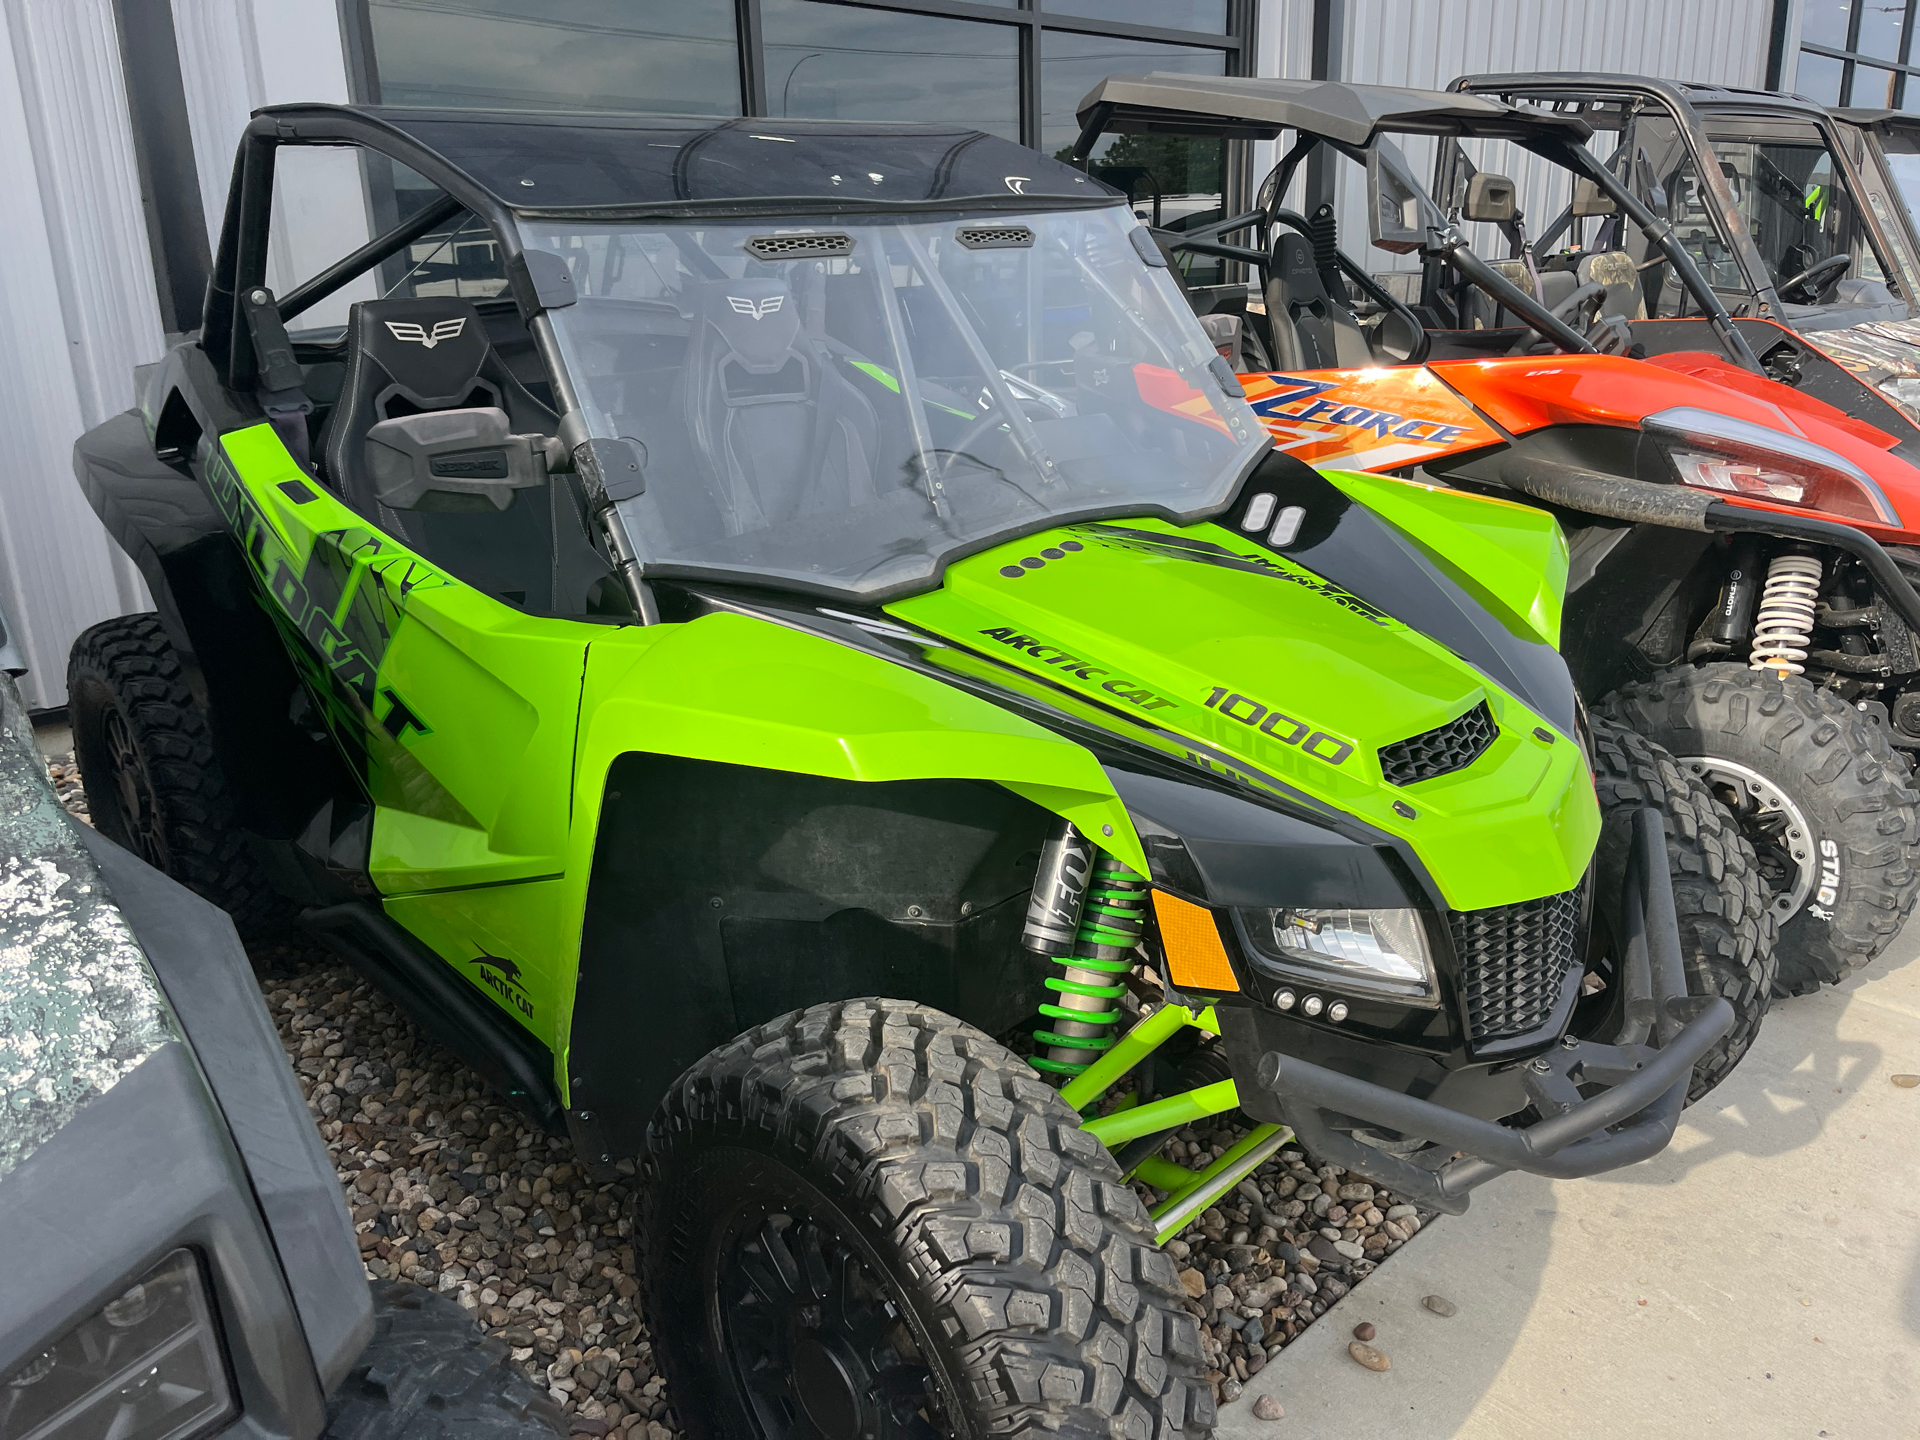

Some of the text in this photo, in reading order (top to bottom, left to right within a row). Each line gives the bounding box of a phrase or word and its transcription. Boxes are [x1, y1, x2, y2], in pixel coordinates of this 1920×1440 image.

[205, 442, 435, 739] WILDCAT
[1725, 581, 1738, 616] CFMOTO
[977, 626, 1180, 711] ARCTIC CAT
[1203, 686, 1354, 766] 1000
[1048, 821, 1092, 927] FOX
[480, 964, 535, 1020] ARCTIC CAT
